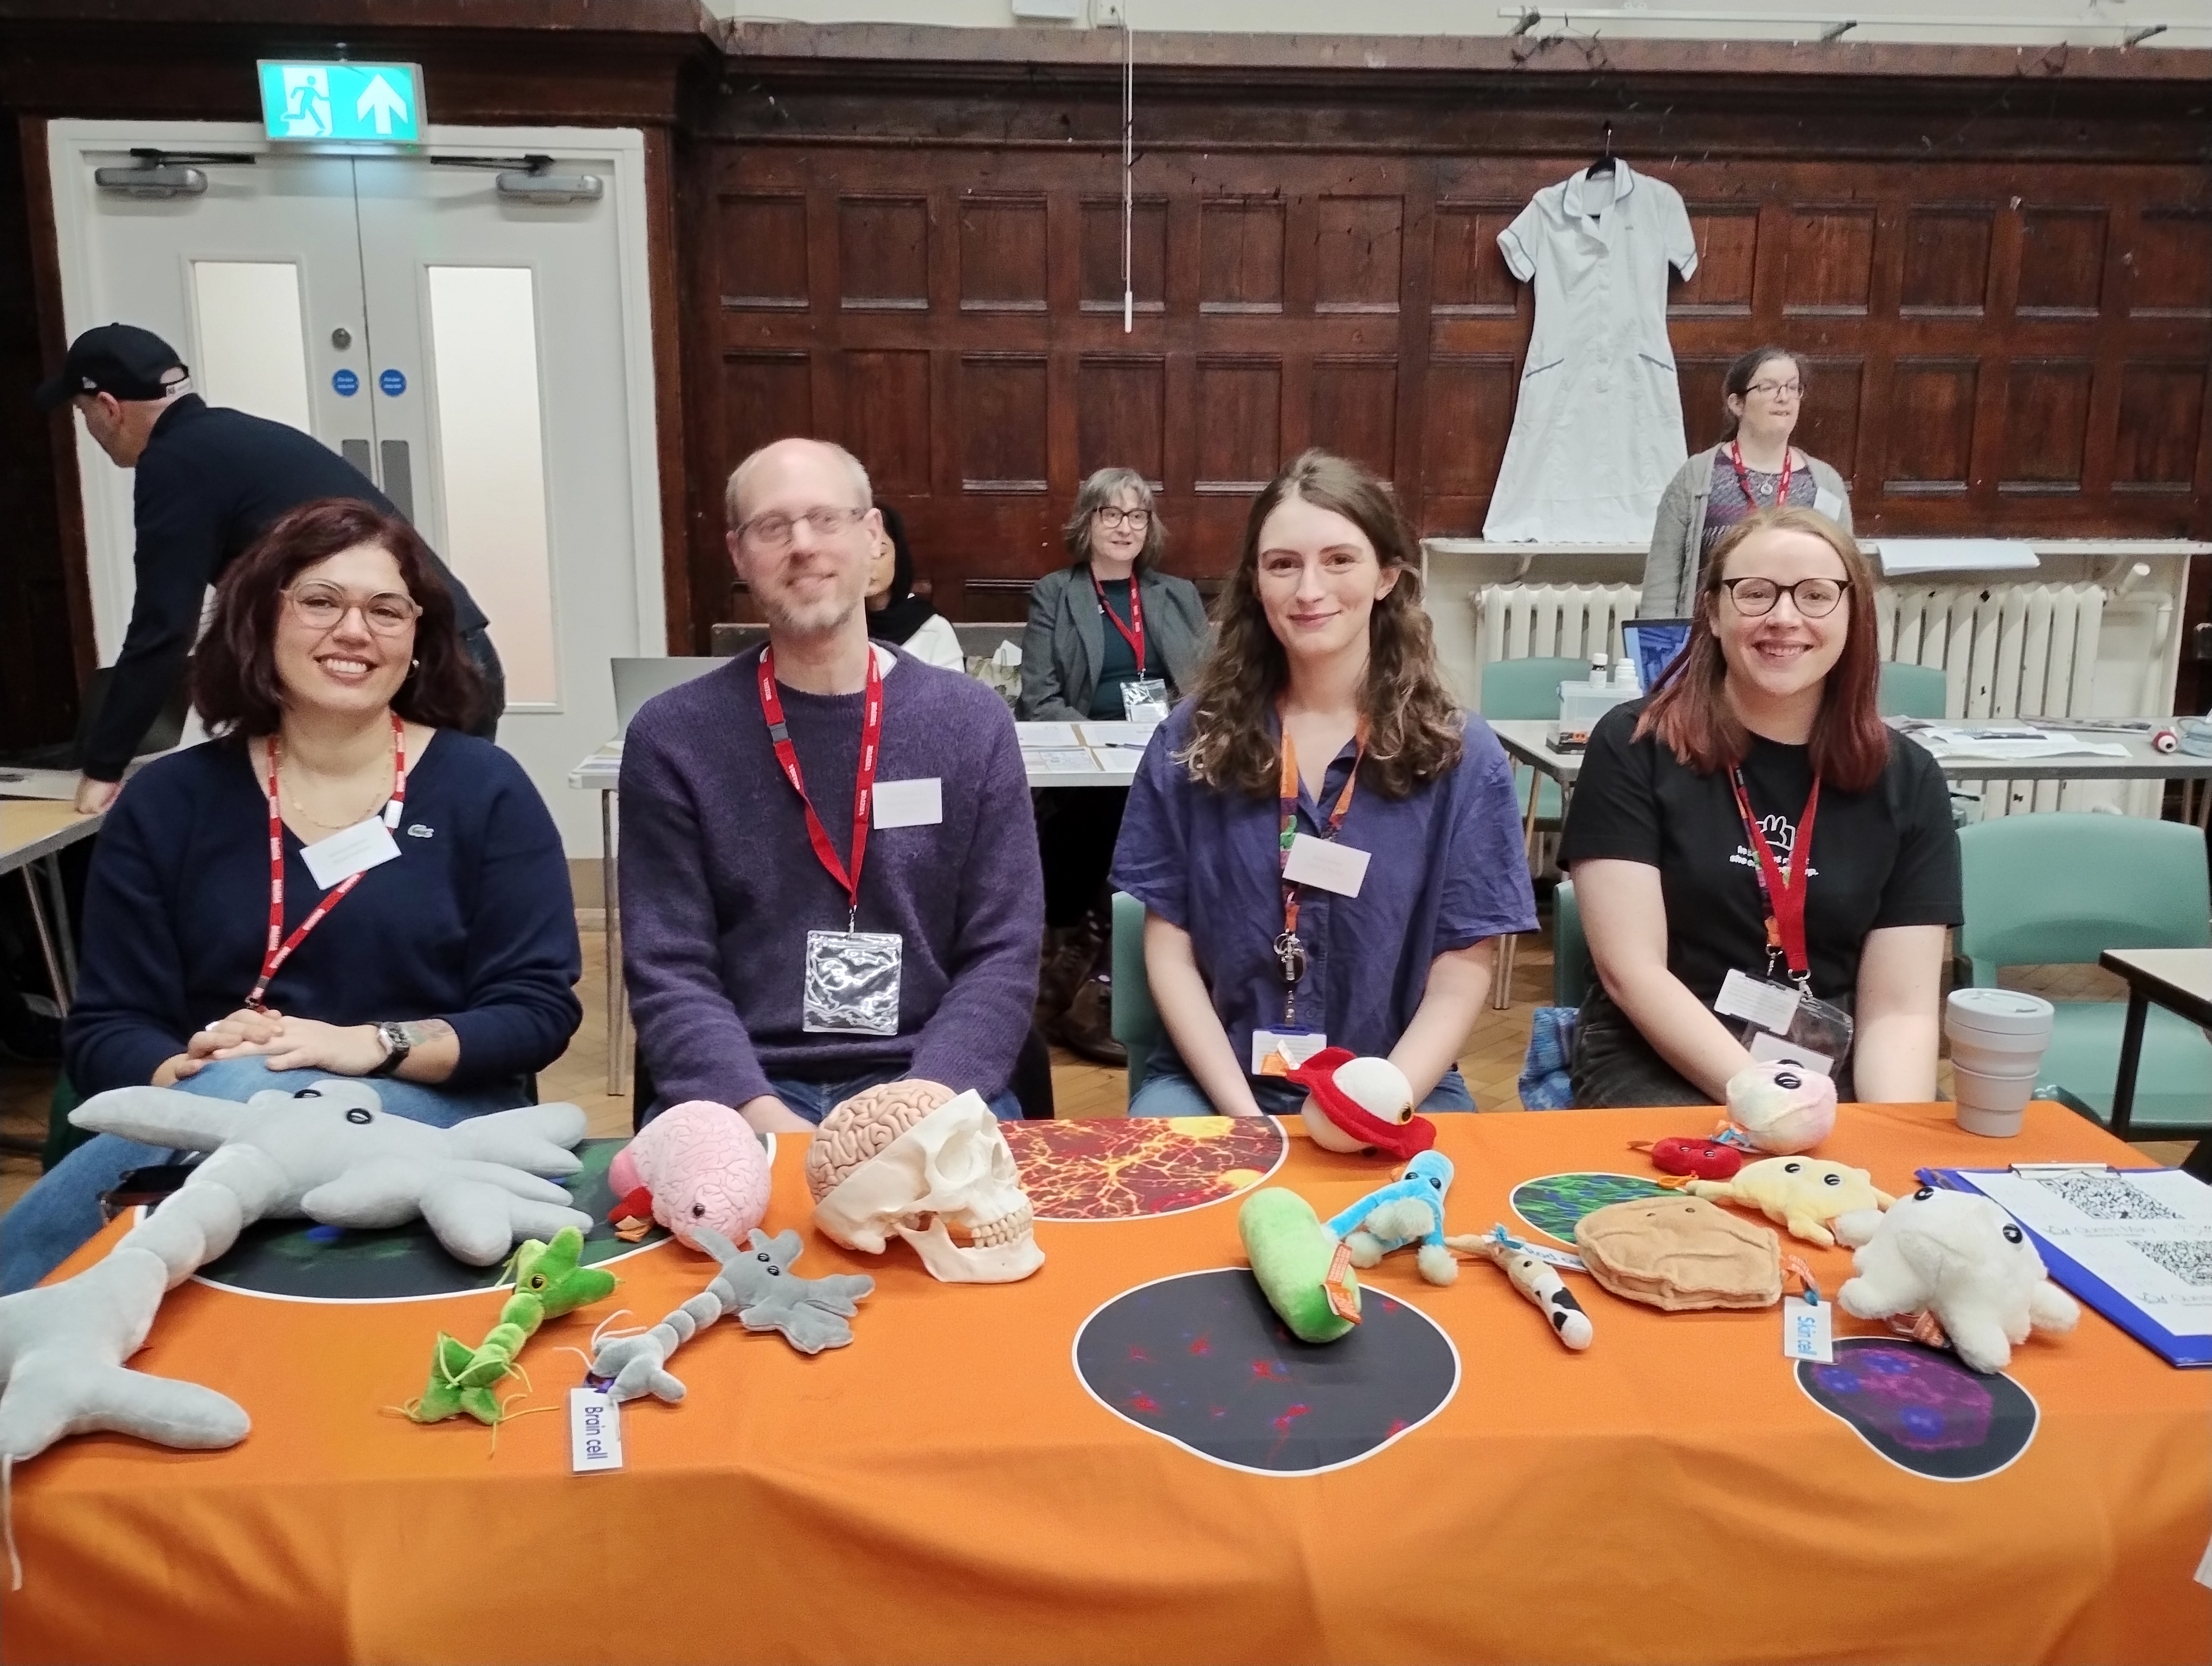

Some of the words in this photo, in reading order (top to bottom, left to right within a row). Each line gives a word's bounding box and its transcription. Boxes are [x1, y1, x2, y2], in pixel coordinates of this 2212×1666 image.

[1797, 1316, 1817, 1337] Skin
[585, 1407, 606, 1436] Brain
[587, 1440, 608, 1459] cell
